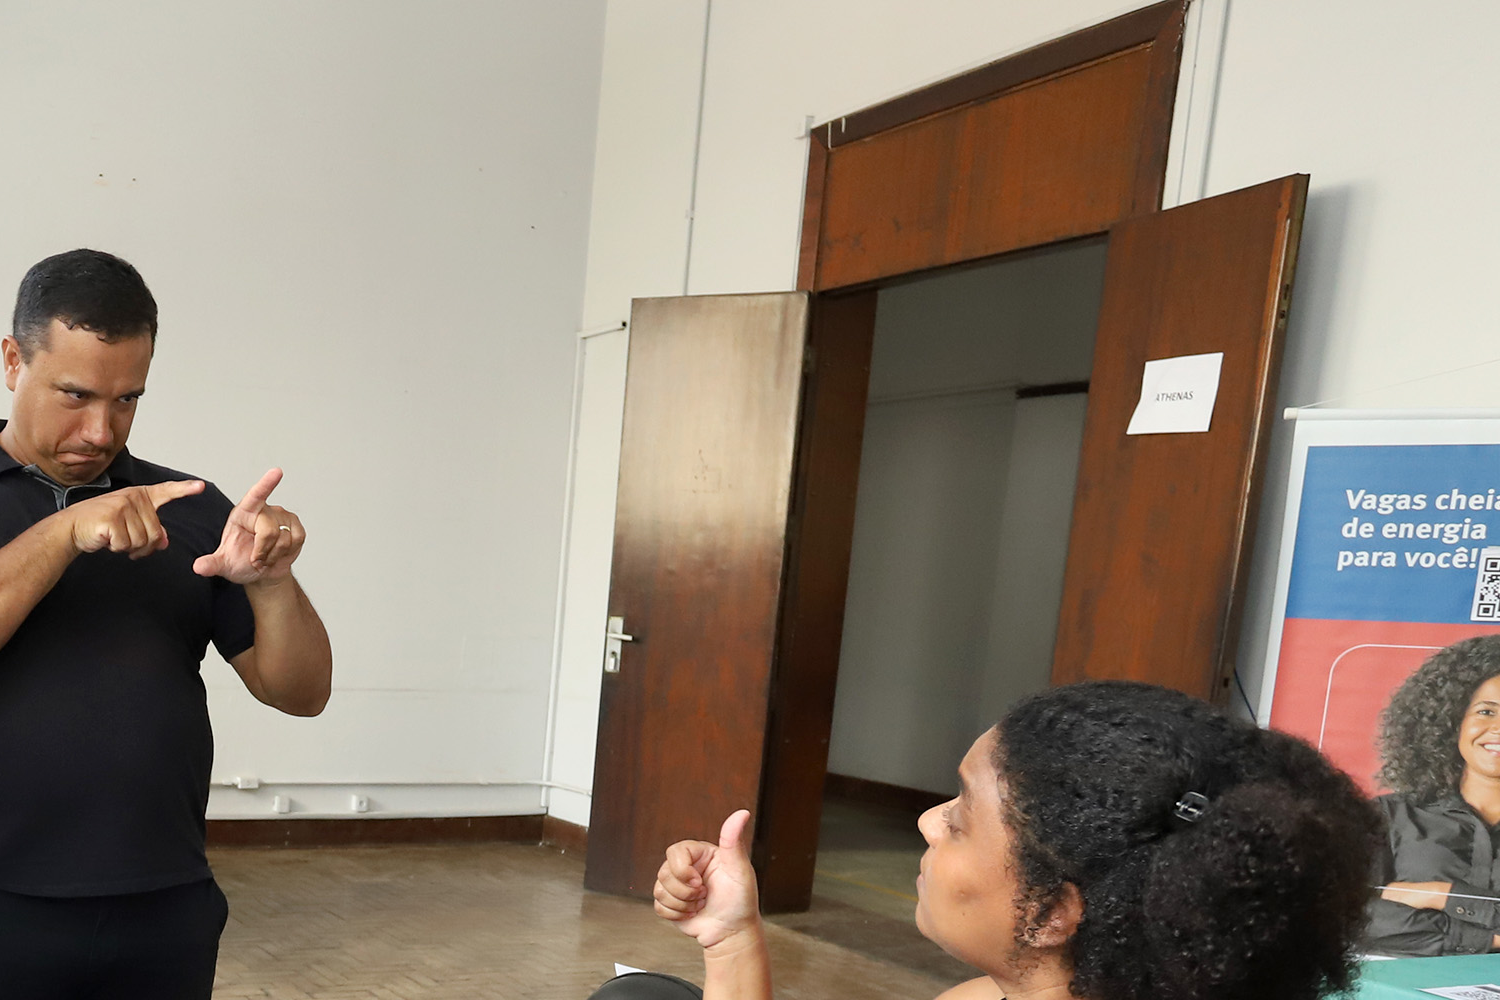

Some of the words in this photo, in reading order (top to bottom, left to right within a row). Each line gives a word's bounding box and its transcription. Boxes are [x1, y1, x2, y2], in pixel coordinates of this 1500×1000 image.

[1346, 489, 1427, 515] Vagas
[1341, 517, 1375, 539] de
[1381, 517, 1487, 544] energia
[1336, 550, 1397, 571] para
[1404, 546, 1479, 569] você!
